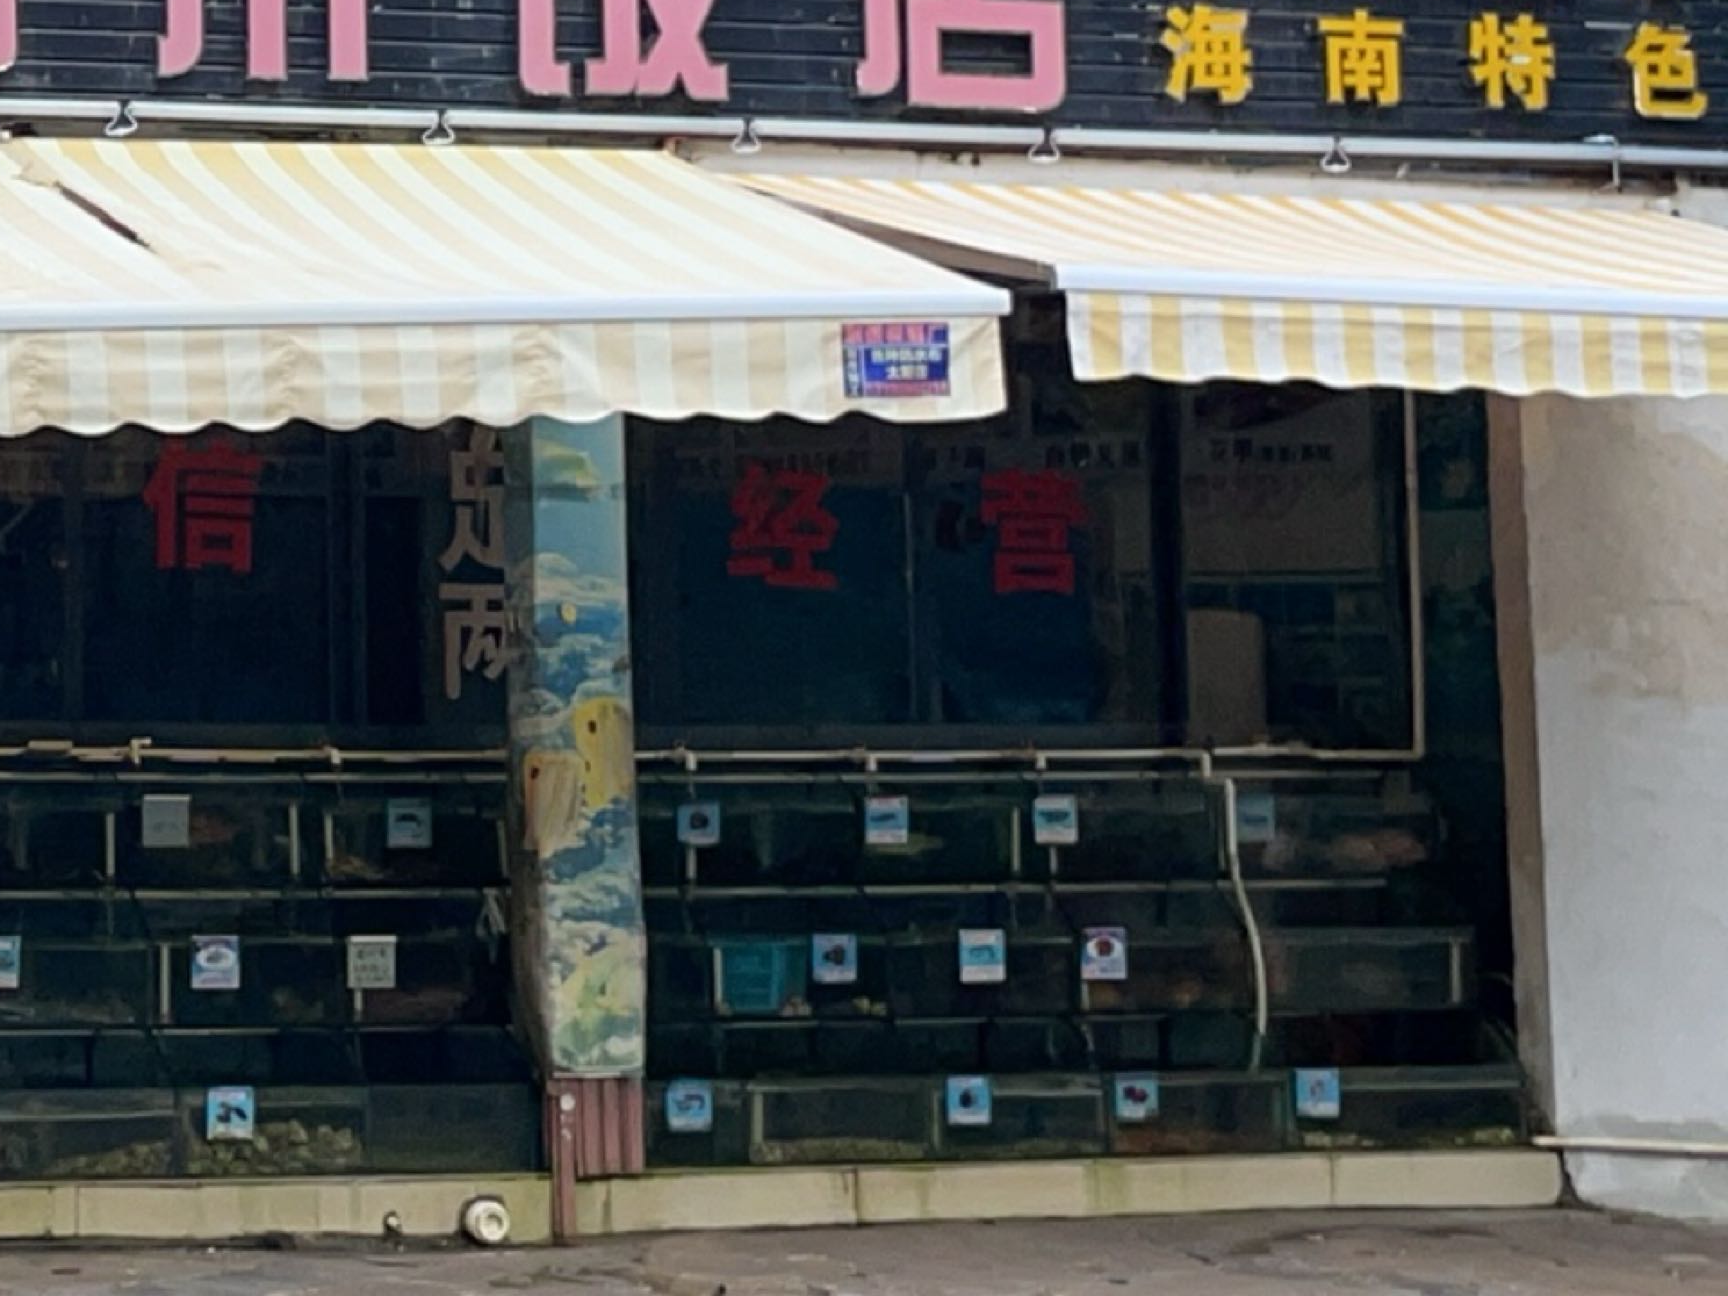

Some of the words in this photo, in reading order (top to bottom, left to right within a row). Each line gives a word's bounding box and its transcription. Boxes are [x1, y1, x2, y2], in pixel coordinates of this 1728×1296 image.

[1162, 5, 1707, 119] 海南特色
[726, 462, 1090, 596] 经营
